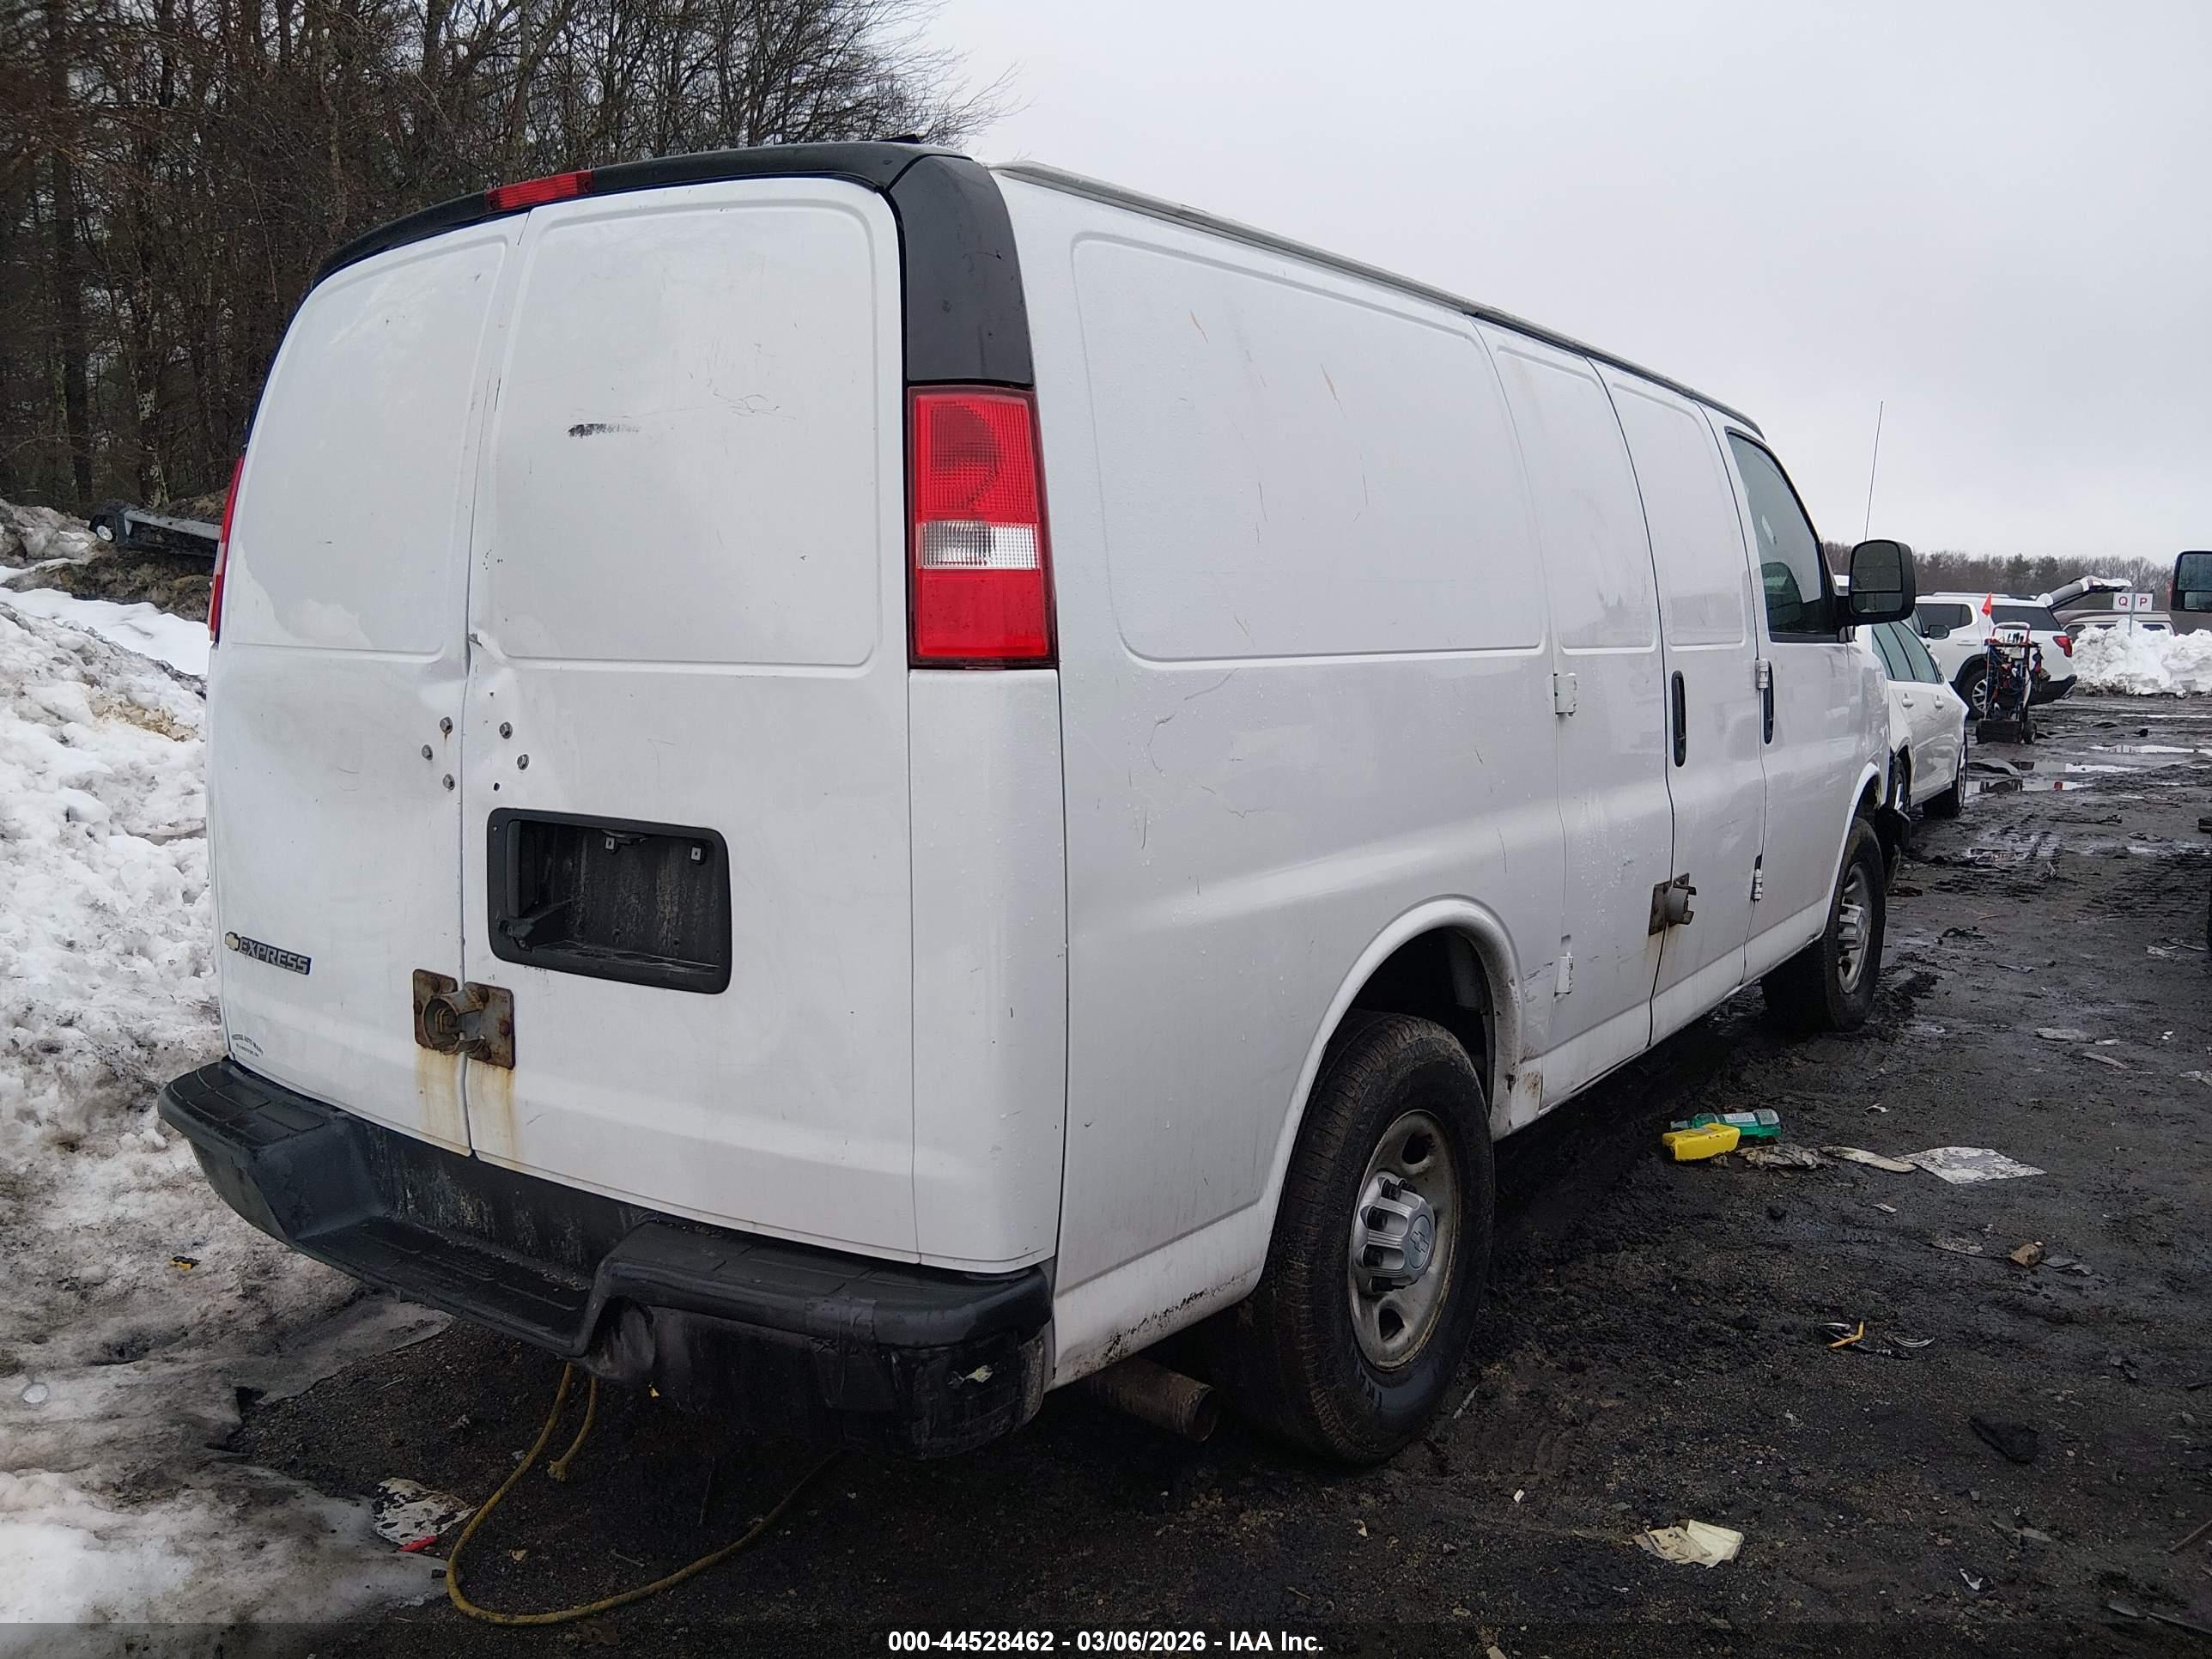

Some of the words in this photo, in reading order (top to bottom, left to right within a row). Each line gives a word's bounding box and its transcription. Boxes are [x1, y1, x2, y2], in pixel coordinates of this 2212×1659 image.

[2118, 596, 2129, 607] Q
[2139, 597, 2148, 607] P
[239, 938, 309, 975] EXPRESS
